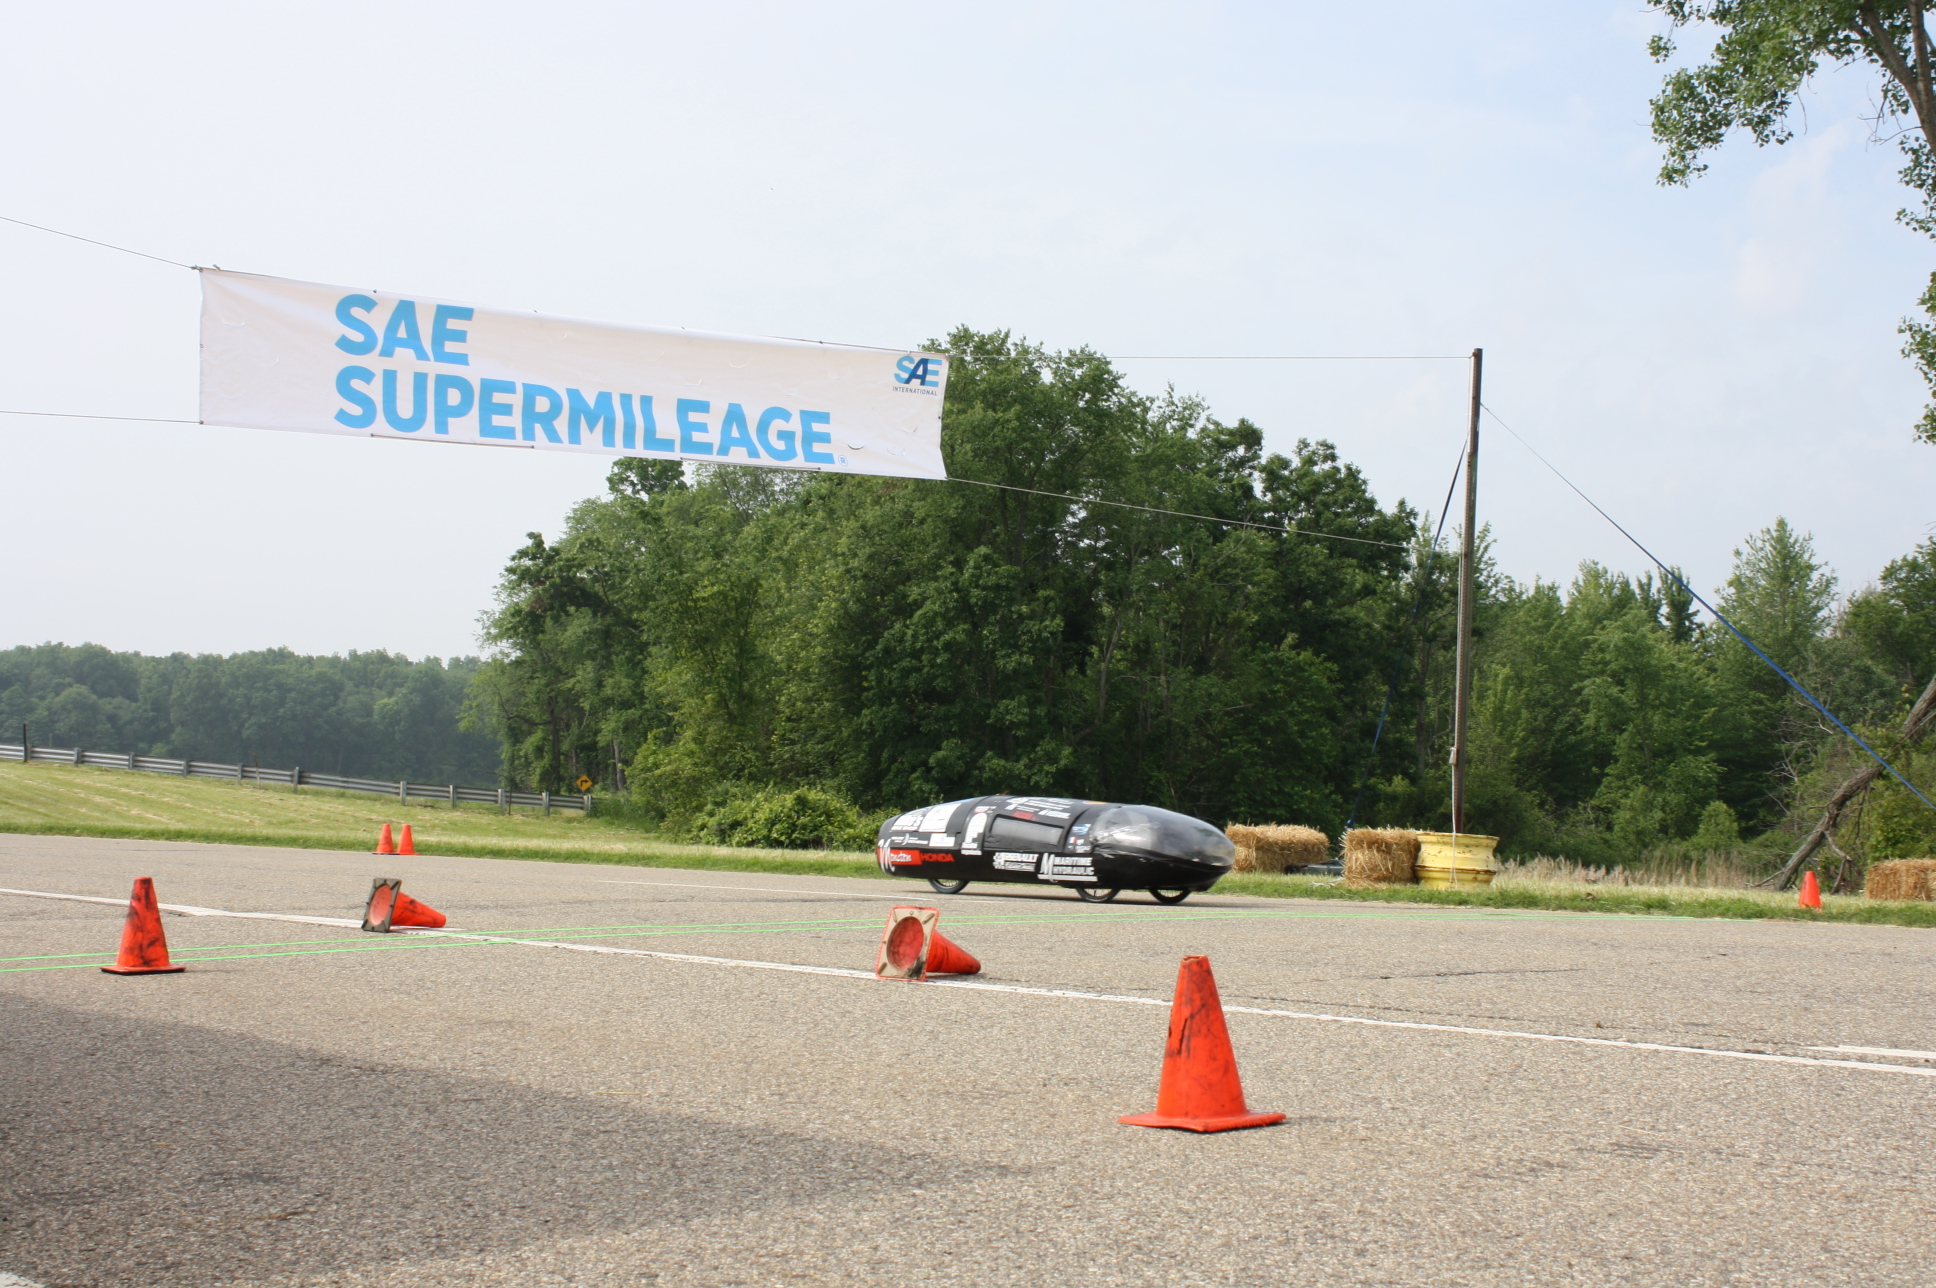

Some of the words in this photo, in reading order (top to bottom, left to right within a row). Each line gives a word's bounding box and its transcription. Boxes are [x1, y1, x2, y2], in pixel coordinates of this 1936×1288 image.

[334, 293, 475, 367] SAE
[893, 355, 943, 388] SAE
[892, 386, 938, 397] INTERNATIONAL
[333, 364, 836, 466] SUPERMILEAGE
[921, 852, 955, 863] HONDA
